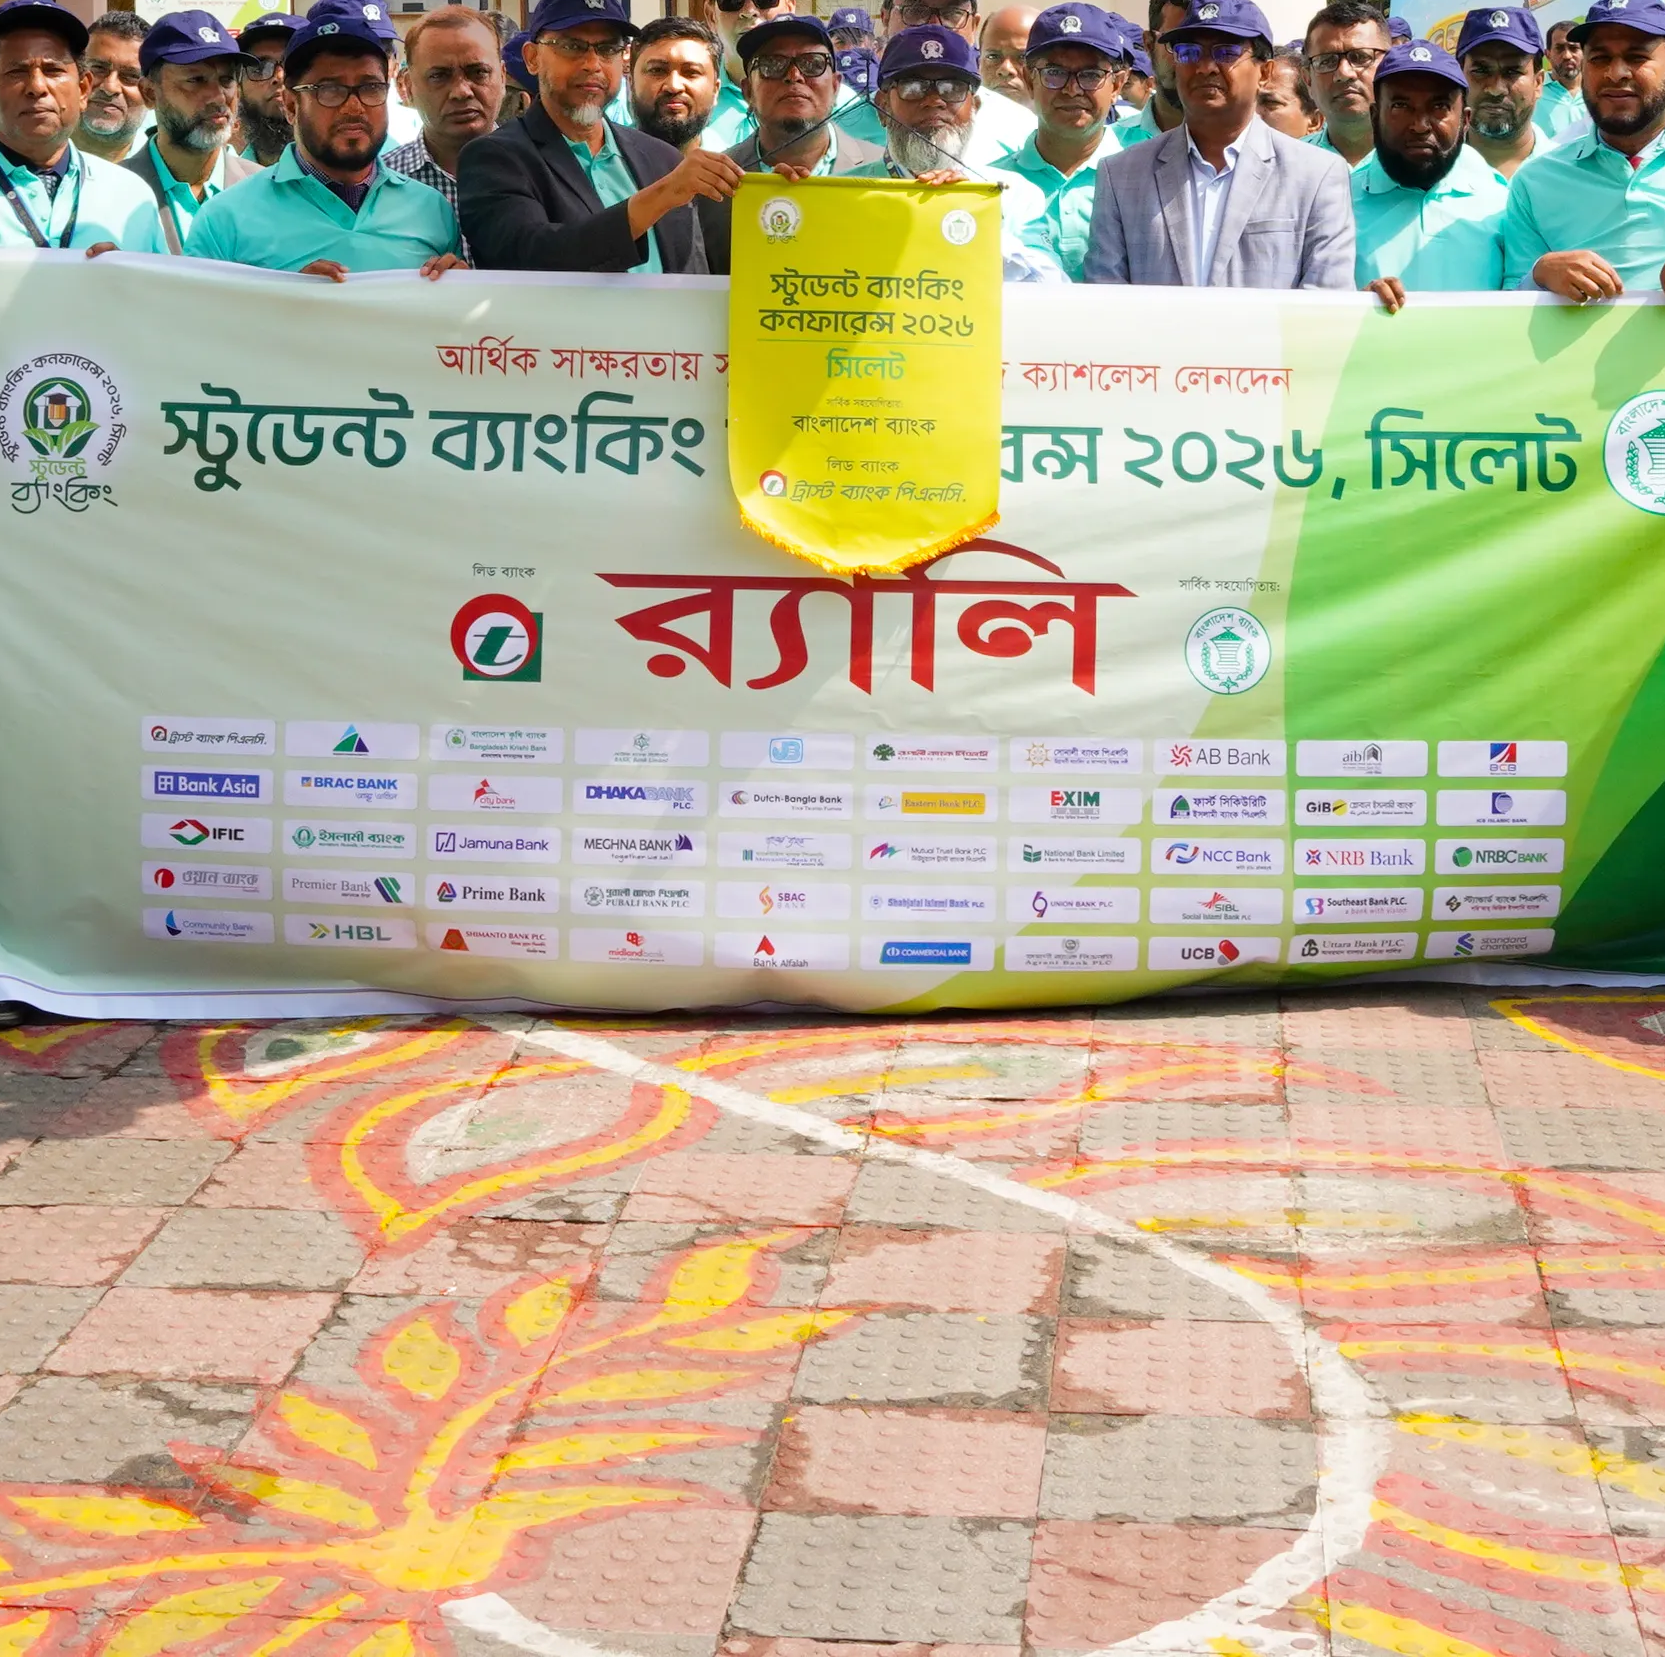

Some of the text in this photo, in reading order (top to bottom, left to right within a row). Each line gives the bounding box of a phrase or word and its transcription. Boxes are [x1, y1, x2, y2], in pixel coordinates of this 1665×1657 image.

[770, 268, 964, 306] স্টুডেন্ট ব্যাংকিং
[758, 309, 974, 337] কনফারেন্স ২০২৬
[437, 335, 540, 377] আর্থিক
[551, 348, 703, 382] সাক্ষরতায়
[826, 348, 906, 380] সিলেট
[1020, 361, 1293, 395] ক্যাশলেস লেনদেন
[31, 353, 106, 379] কনফারেন্স
[97, 422, 127, 466] সিলেট
[792, 415, 936, 436] বাংলাদেশ ব্যাংক
[160, 383, 705, 492] স্টুডেন্ট ব্যাংকিং
[1124, 426, 1346, 501] ২০২৬,
[1365, 407, 1582, 493] সিলেট
[29, 455, 87, 481] স্টুডেন্ট
[827, 456, 899, 473] লিড ব্যাংক
[11, 475, 118, 514] ব্যাংকিং
[790, 480, 835, 502] ট্রাস্ট
[841, 485, 891, 502] ব্যাংক
[472, 563, 536, 578] লিড ব্যাংক
[1179, 578, 1211, 591] সার্বিক
[1195, 613, 1259, 640] বাংলাদেশ ব্যাংক
[168, 731, 194, 744] ট্রাস্ট
[196, 732, 224, 744] ব্যাংক
[470, 744, 507, 752] Bangladesh
[510, 744, 528, 752] Krishi
[1054, 746, 1128, 758] সোনালী ব্যাংক পিএলসি
[1196, 749, 1270, 766] AB Bank
[178, 775, 256, 794] Bank Asia
[314, 777, 398, 790] BRAC BANK
[480, 797, 515, 806] city bank
[753, 793, 842, 805] Dutch-Bangla Bank
[905, 799, 936, 808] Eastern
[939, 799, 960, 808] Bank
[1051, 791, 1100, 807] EXIM
[1193, 795, 1267, 808] ফার্স্ট সিকিউরিটি
[673, 802, 694, 810] PLC.
[1193, 809, 1267, 819] ইসলামী ব্যাংক পিএলসি
[212, 827, 244, 841] IFIC
[318, 829, 405, 844] ইসলামী ব্যাংক
[460, 837, 549, 851] Jamuna Bank
[584, 838, 672, 852] MEGHNA BANK
[911, 847, 986, 855] Mutual Trust Bank PLC
[1044, 849, 1125, 858] National Bank Limited
[1203, 850, 1271, 863] NCC Bank
[1326, 849, 1414, 866] NRB Bank
[1476, 850, 1548, 863] NRBC BANK
[292, 878, 371, 892] Premier Bank
[462, 886, 546, 902] Prime Bank
[778, 892, 806, 902] SBAC
[1215, 904, 1239, 912] SIBL
[1327, 897, 1407, 907] Southeast Bank PLC.
[183, 920, 254, 931] Community Bank
[335, 924, 391, 941] HBL
[466, 931, 546, 941] SHIMANTO BANK PLC.
[1322, 940, 1353, 949] Uttara
[1355, 940, 1377, 948] Bank
[1480, 942, 1527, 950] chartered
[1481, 936, 1527, 944] standard
[901, 948, 968, 957] COMMERCIAL BANK
[1181, 948, 1215, 960] UCB
[753, 958, 808, 968] Bank Alfalah
